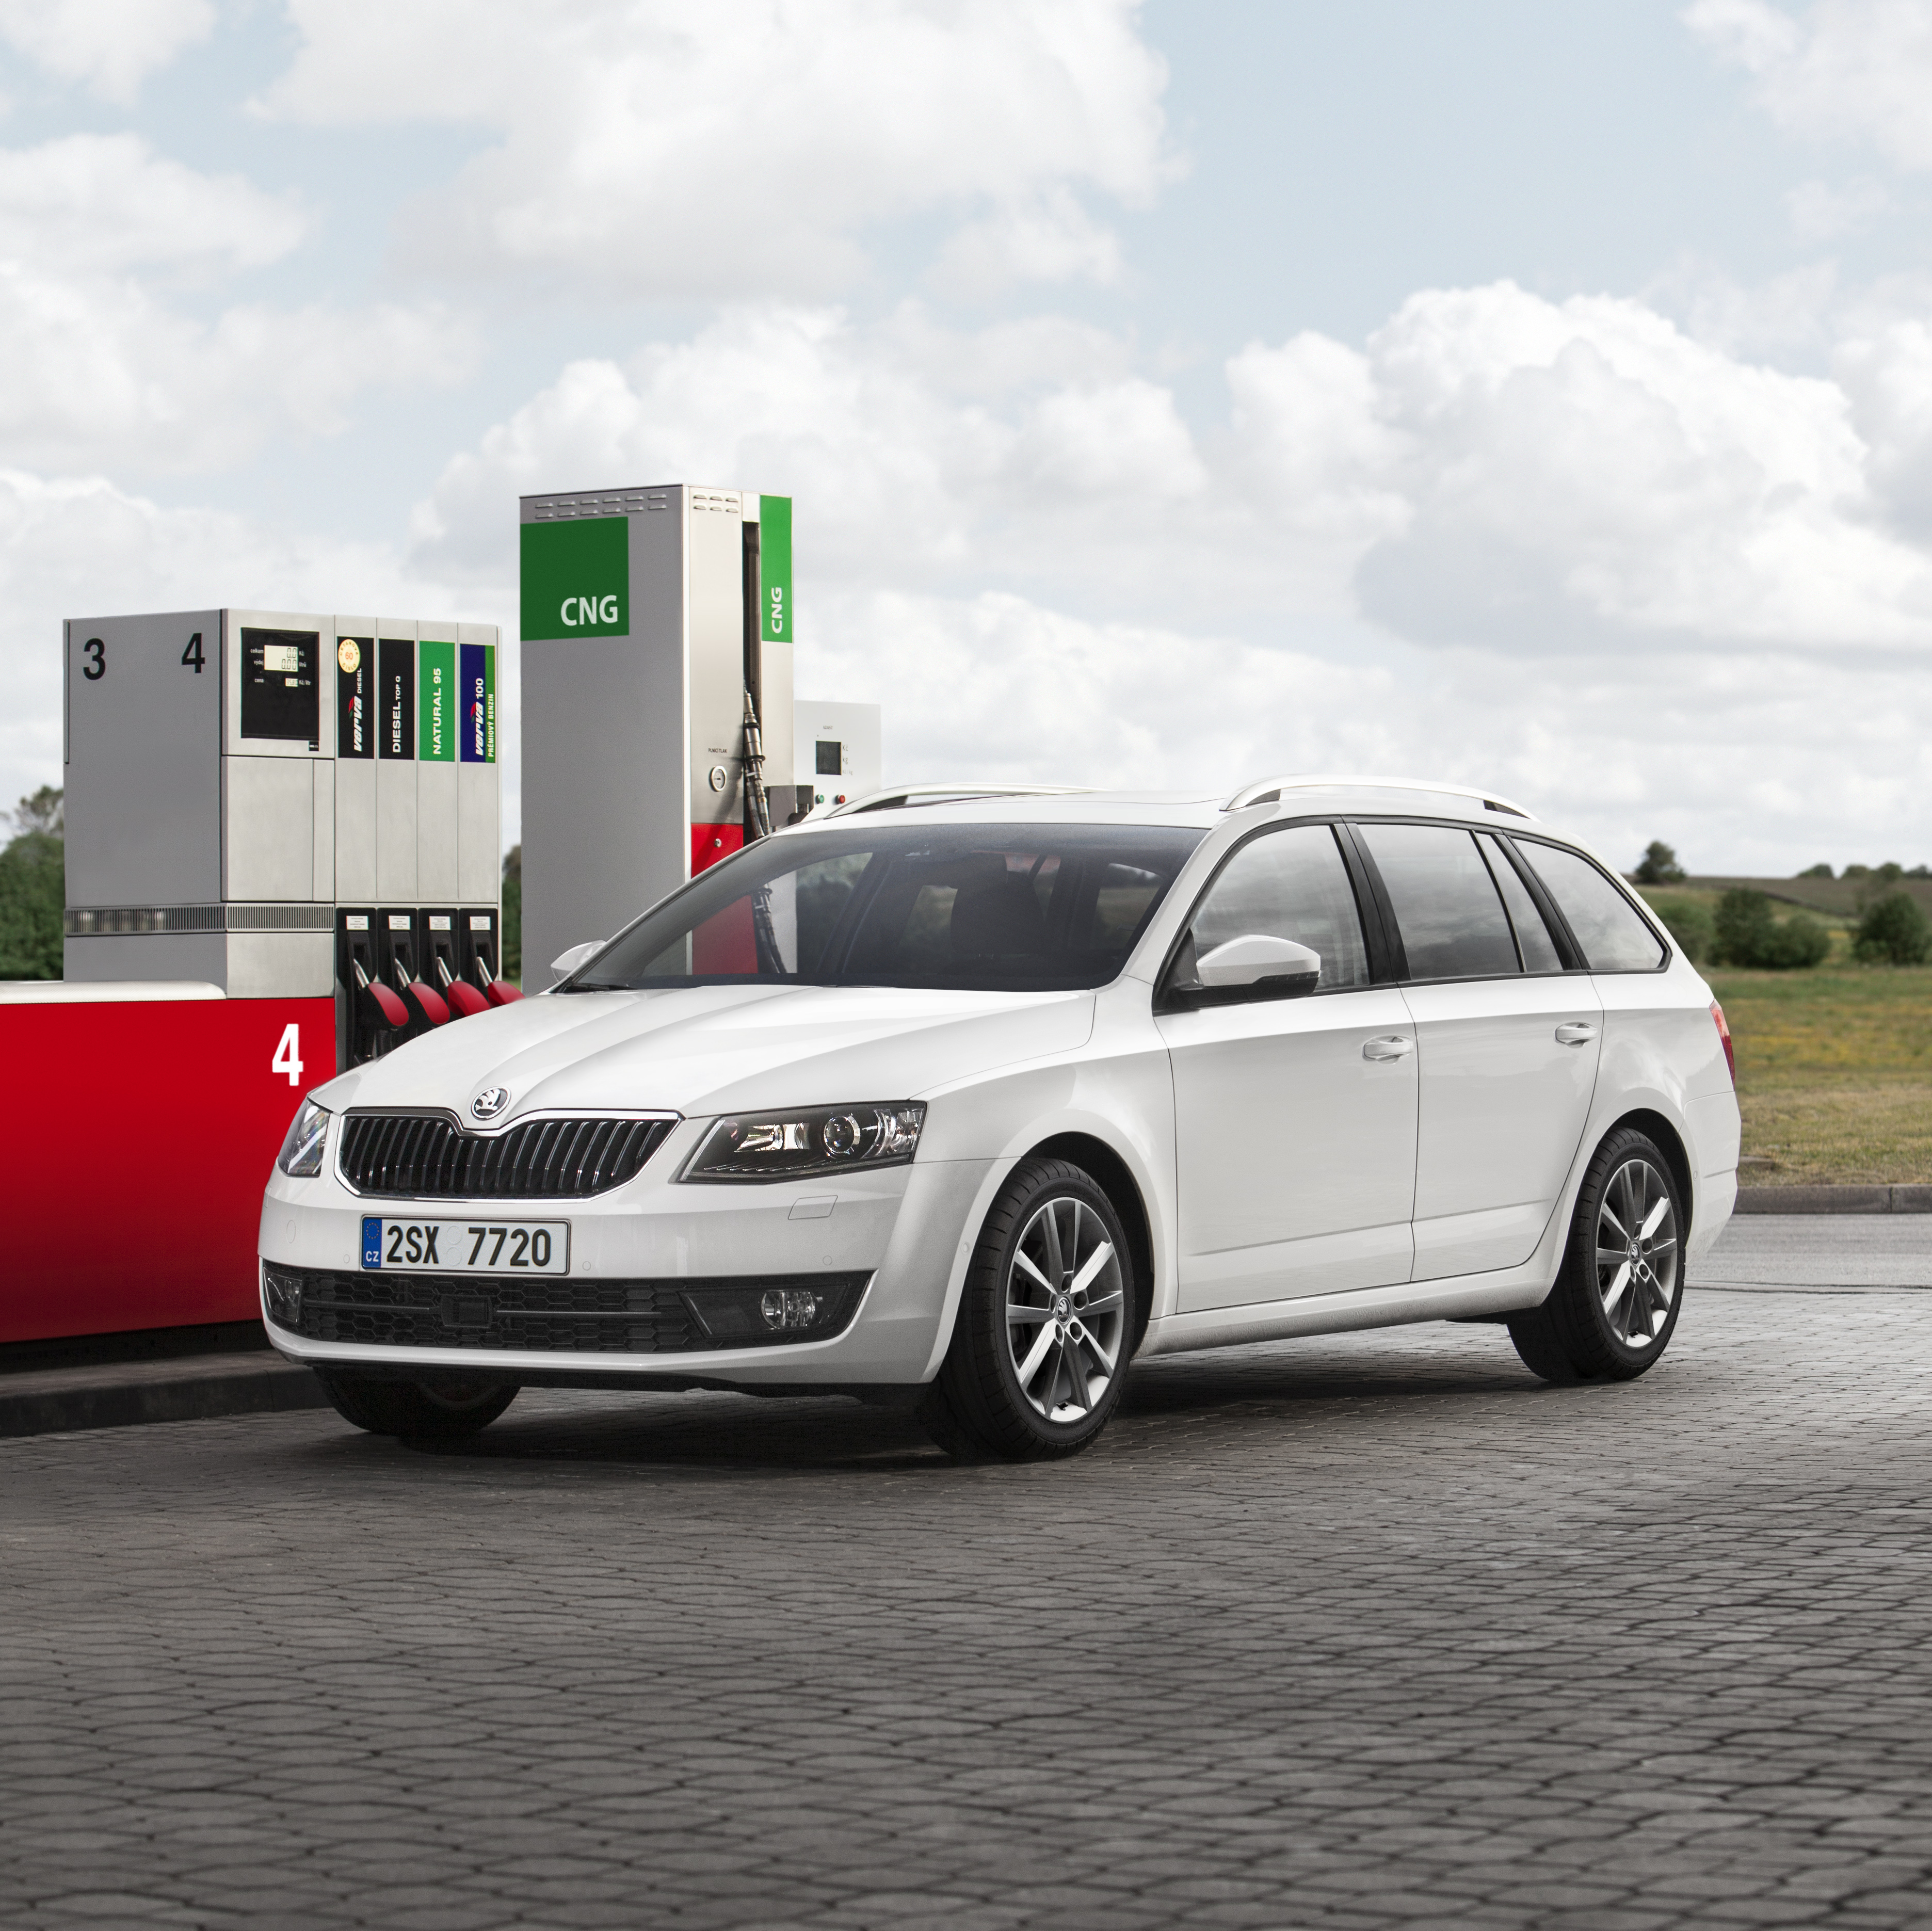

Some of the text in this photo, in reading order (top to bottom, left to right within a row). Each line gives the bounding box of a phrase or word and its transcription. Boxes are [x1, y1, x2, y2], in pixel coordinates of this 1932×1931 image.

[560, 594, 618, 626] CNG
[771, 587, 782, 634] CNG
[83, 637, 106, 681] 3
[181, 632, 206, 674] 4
[345, 652, 353, 660] 60
[475, 678, 484, 699] 100
[392, 701, 401, 753] DIESEL
[433, 668, 442, 755] NATURAL 95
[842, 755, 848, 765] kg
[272, 1023, 303, 1086] 4
[365, 1250, 379, 1262] CZ
[387, 1225, 552, 1267] 2SX 7720
